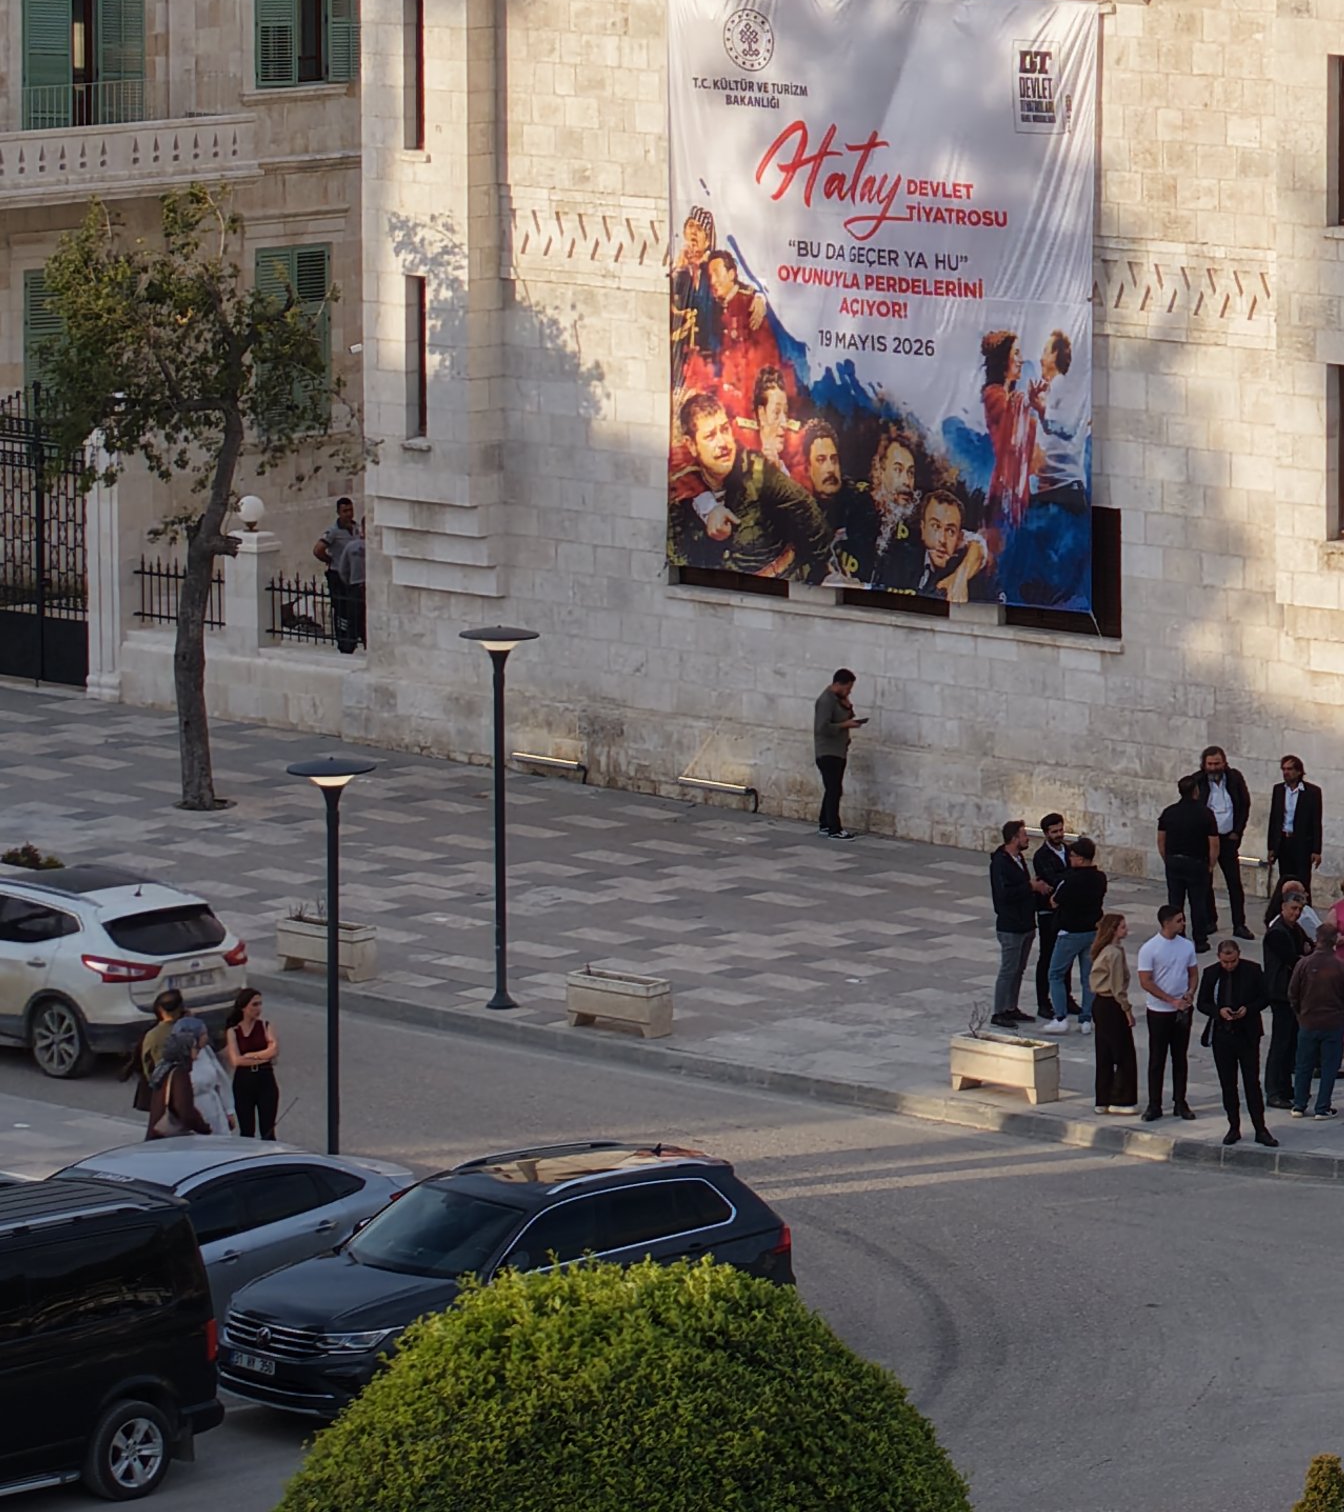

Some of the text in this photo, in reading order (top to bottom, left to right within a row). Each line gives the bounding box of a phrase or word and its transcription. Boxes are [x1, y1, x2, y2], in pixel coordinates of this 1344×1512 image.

[1019, 50, 1052, 75] DT
[692, 77, 808, 96] T.C. KÜLTÜR VE TURİZM
[1019, 77, 1053, 99] DEVLET
[725, 94, 780, 109] BAKANLIĞI
[756, 120, 909, 241] Hatay
[906, 178, 974, 200] DEVLET
[906, 201, 1008, 228] TİYATROSU
[825, 243, 846, 262] DA
[849, 246, 899, 269] GEÇER
[904, 251, 929, 270] YA
[777, 264, 984, 299] OYUNUYLA PERDELERİNİ
[839, 297, 908, 319] AÇIYOR!
[818, 329, 936, 357] 19 MAYIS 2026
